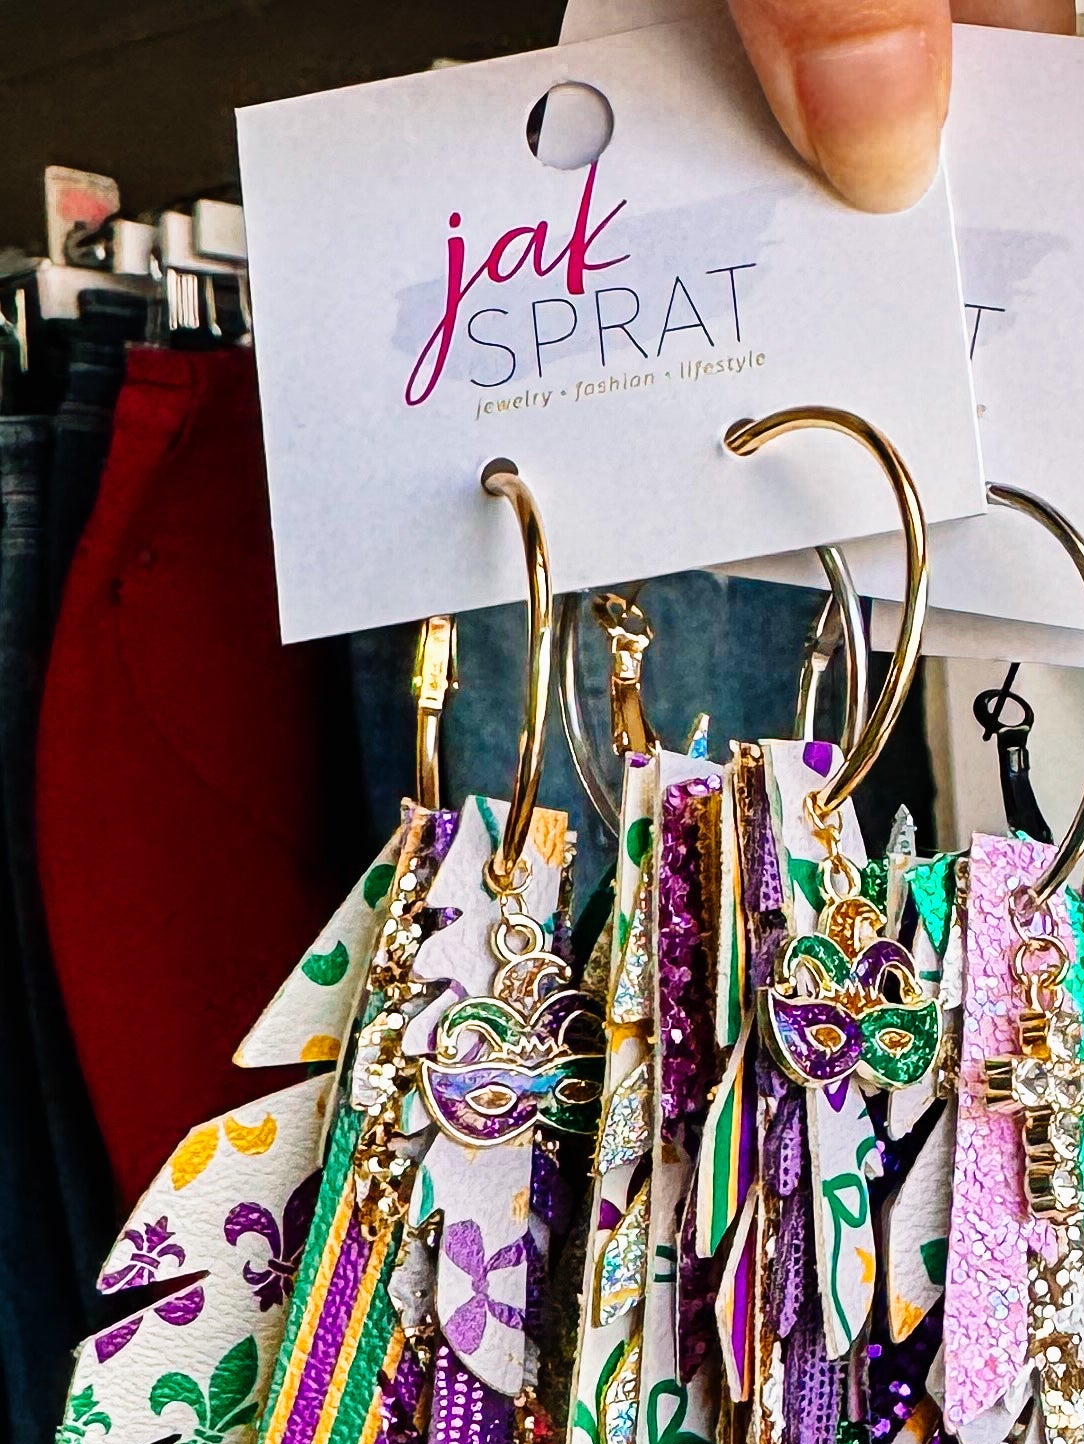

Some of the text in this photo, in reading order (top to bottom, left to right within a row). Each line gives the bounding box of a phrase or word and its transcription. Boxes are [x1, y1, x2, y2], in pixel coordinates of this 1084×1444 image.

[405, 160, 632, 406] jak
[466, 262, 757, 389] SPRAT
[475, 349, 767, 420] jewelry fashion lifestyle
